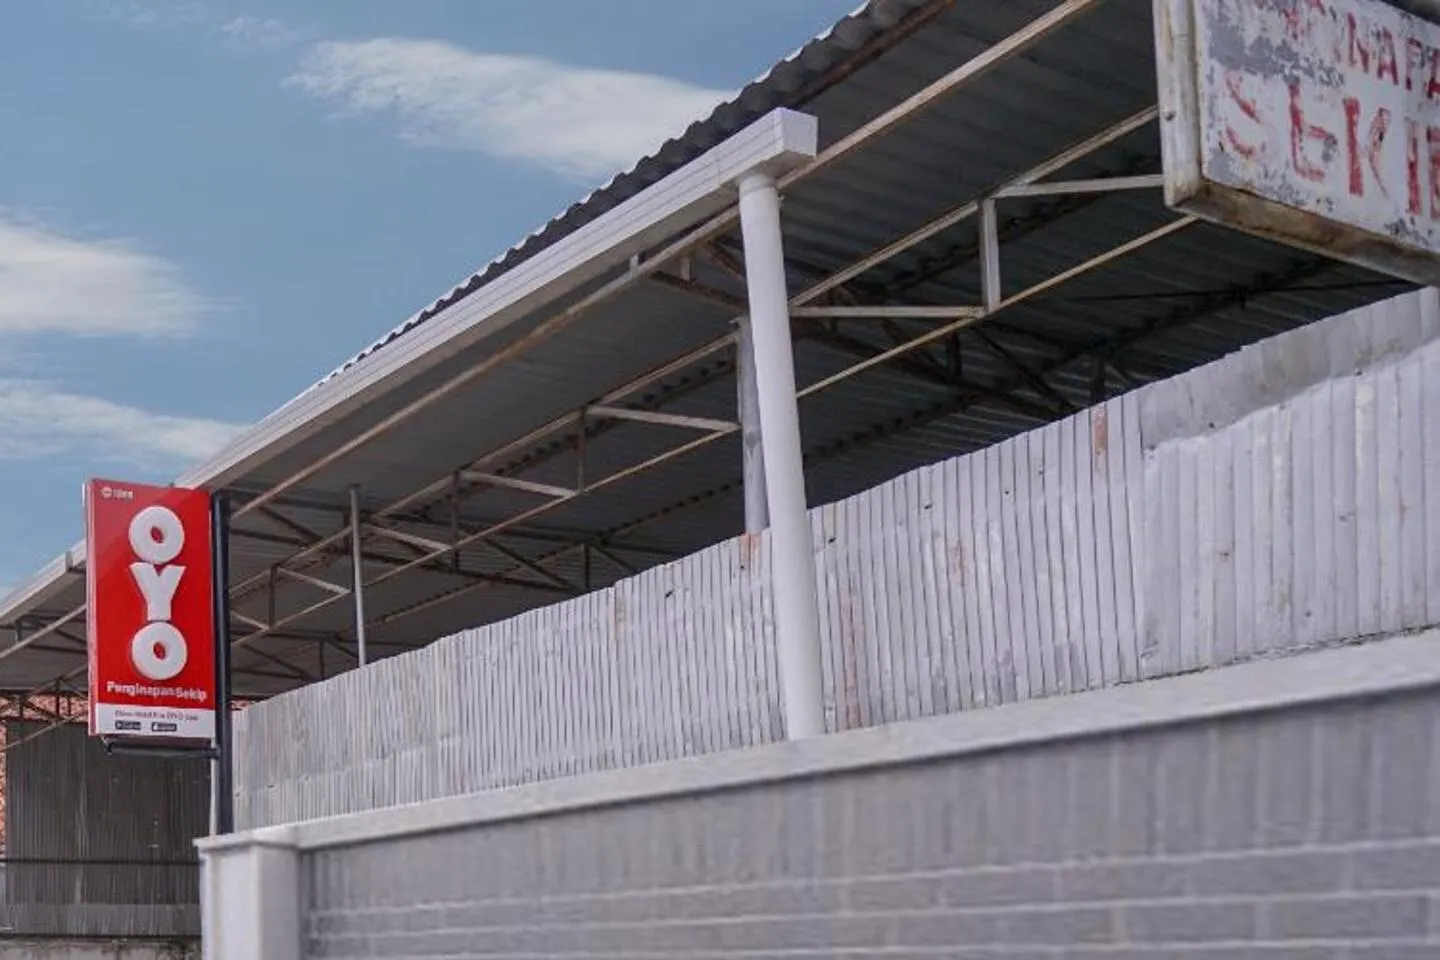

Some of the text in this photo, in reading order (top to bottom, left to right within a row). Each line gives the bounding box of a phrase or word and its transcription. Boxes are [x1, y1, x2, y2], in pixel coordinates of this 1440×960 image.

[128, 505, 188, 680] OYO
[107, 681, 208, 702] Penginapan Sekip
